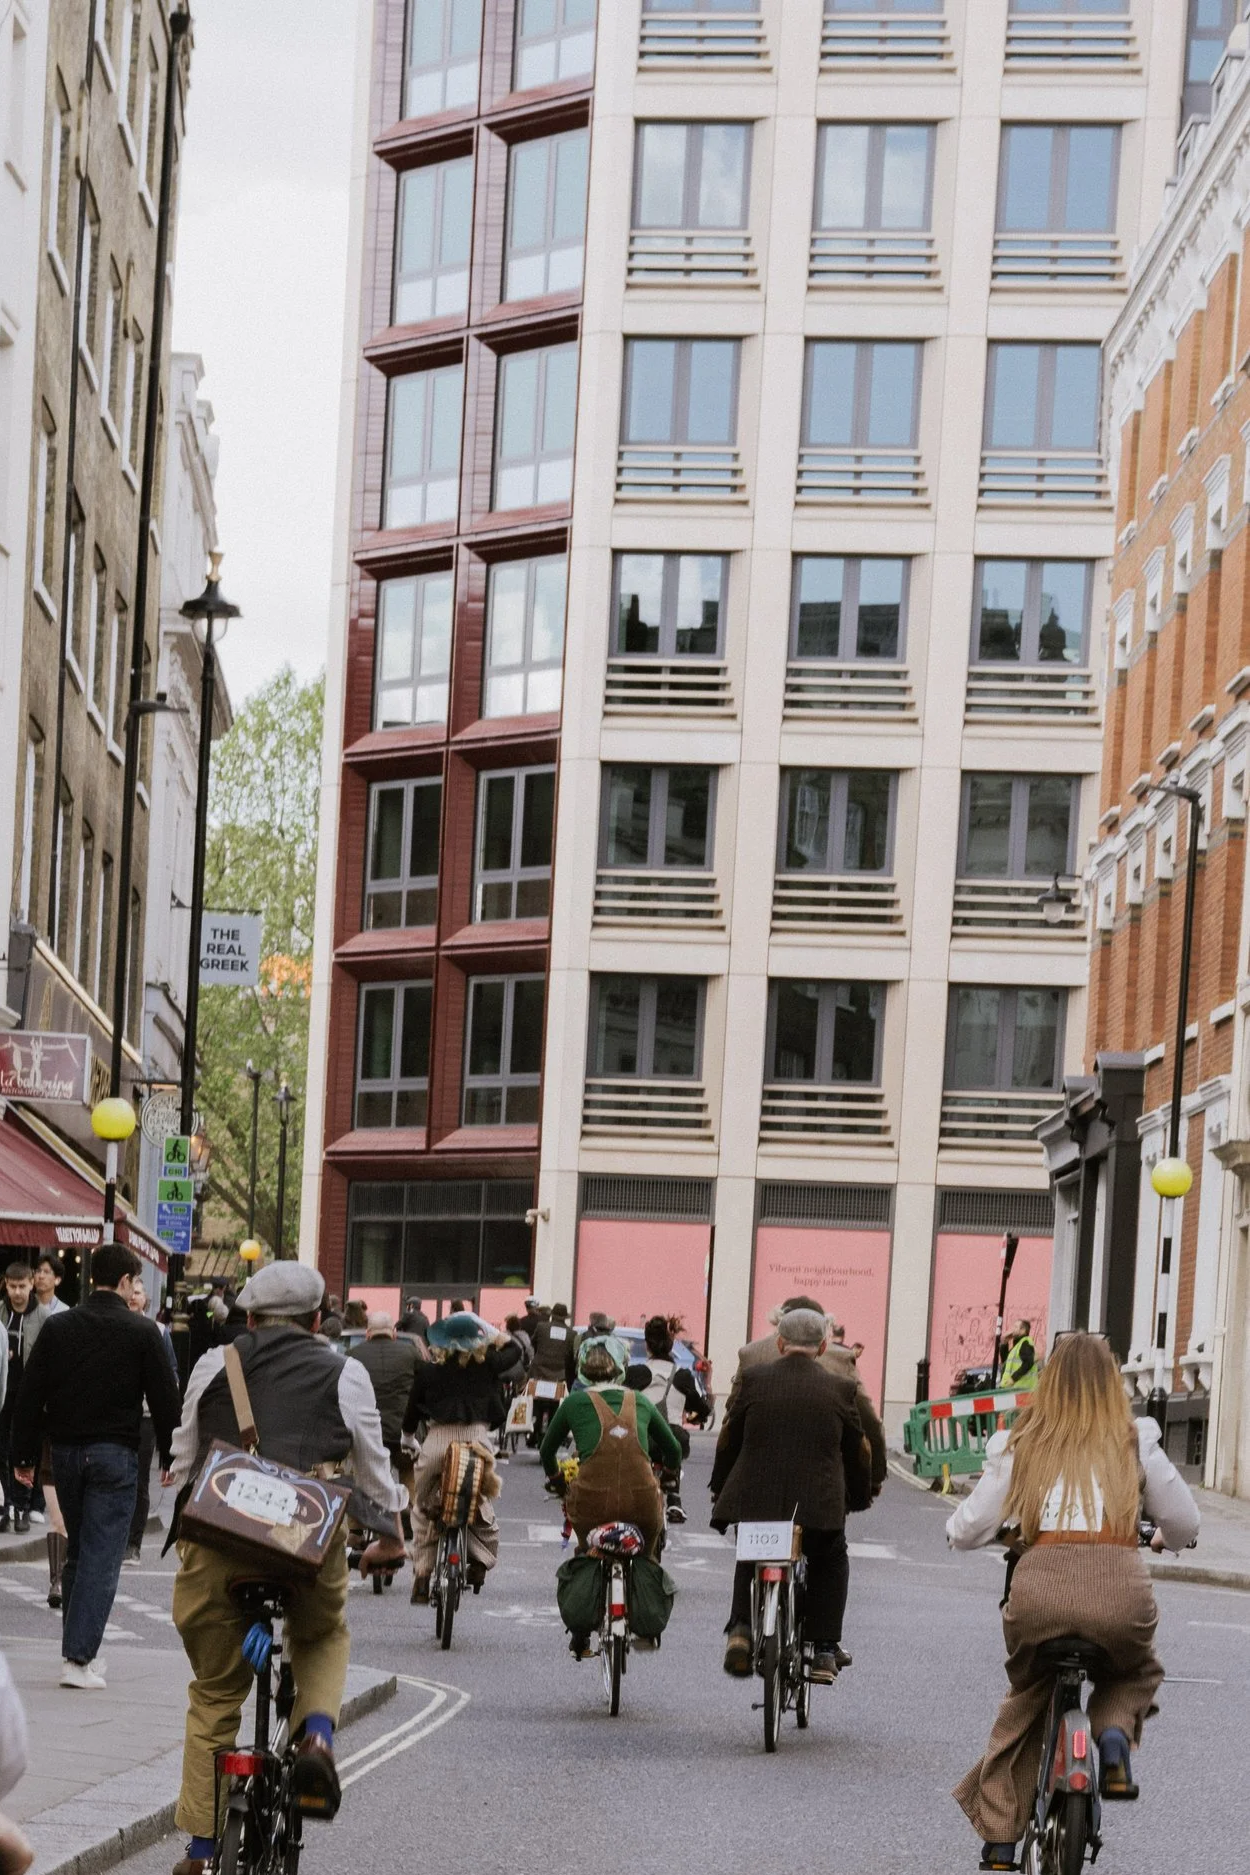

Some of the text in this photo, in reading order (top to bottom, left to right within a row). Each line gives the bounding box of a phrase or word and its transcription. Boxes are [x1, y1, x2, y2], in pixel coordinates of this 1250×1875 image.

[211, 927, 240, 941] THE
[206, 942, 247, 957] REAL
[200, 957, 250, 973] GREEK
[770, 1264, 802, 1274] Vibrant
[794, 1276, 848, 1287] happy talent
